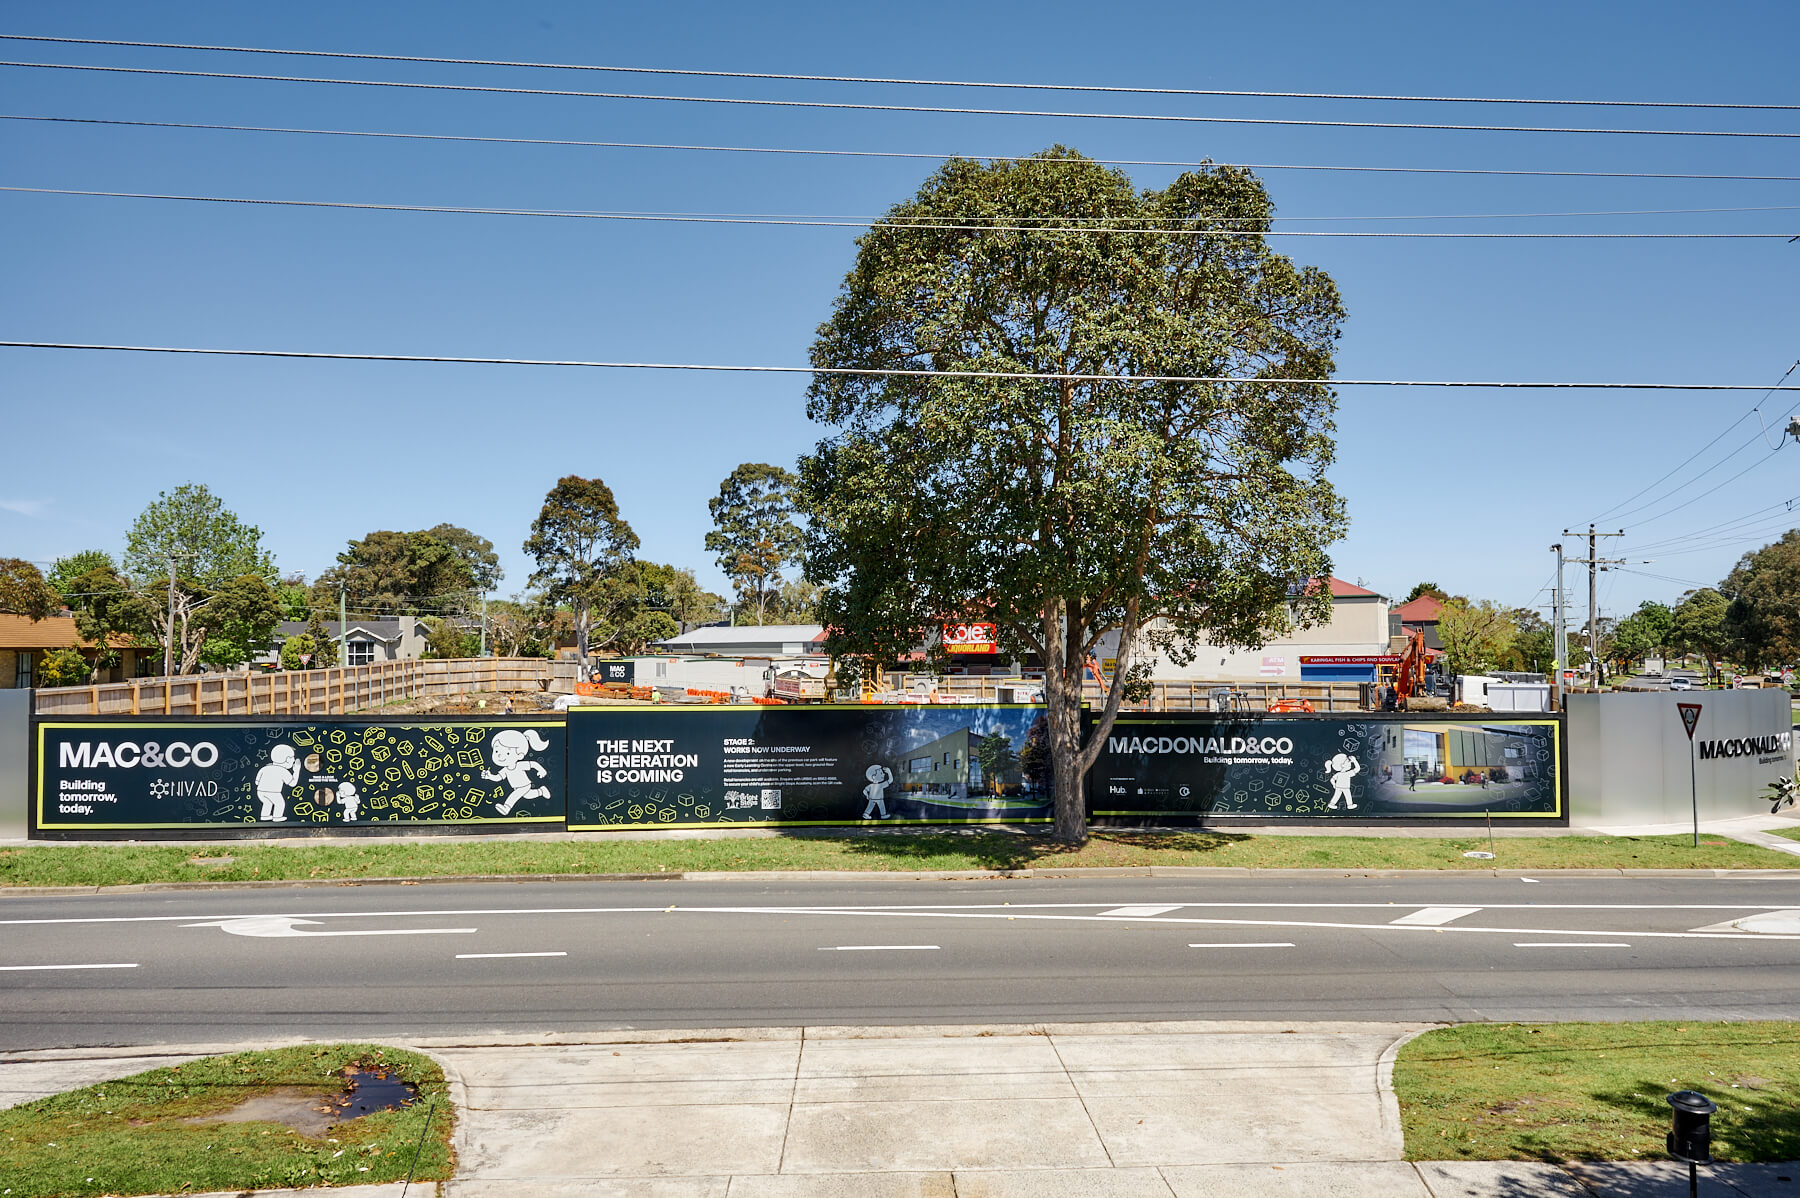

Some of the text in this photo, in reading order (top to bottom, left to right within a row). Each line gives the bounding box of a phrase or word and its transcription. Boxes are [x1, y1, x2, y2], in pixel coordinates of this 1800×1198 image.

[596, 740, 674, 753] THE NEXT
[723, 746, 750, 754] WORKS
[1109, 737, 1294, 755] MACDONALD&CO
[59, 741, 219, 768] MAC&CO
[1203, 756, 1233, 765] Building
[1271, 756, 1294, 765] today.
[596, 755, 698, 768] GENERATION
[597, 769, 684, 784] IS COMING
[59, 780, 106, 792] Building
[1109, 785, 1128, 794] Hub.
[59, 792, 118, 803] tomorrow,
[59, 804, 94, 816] today.
